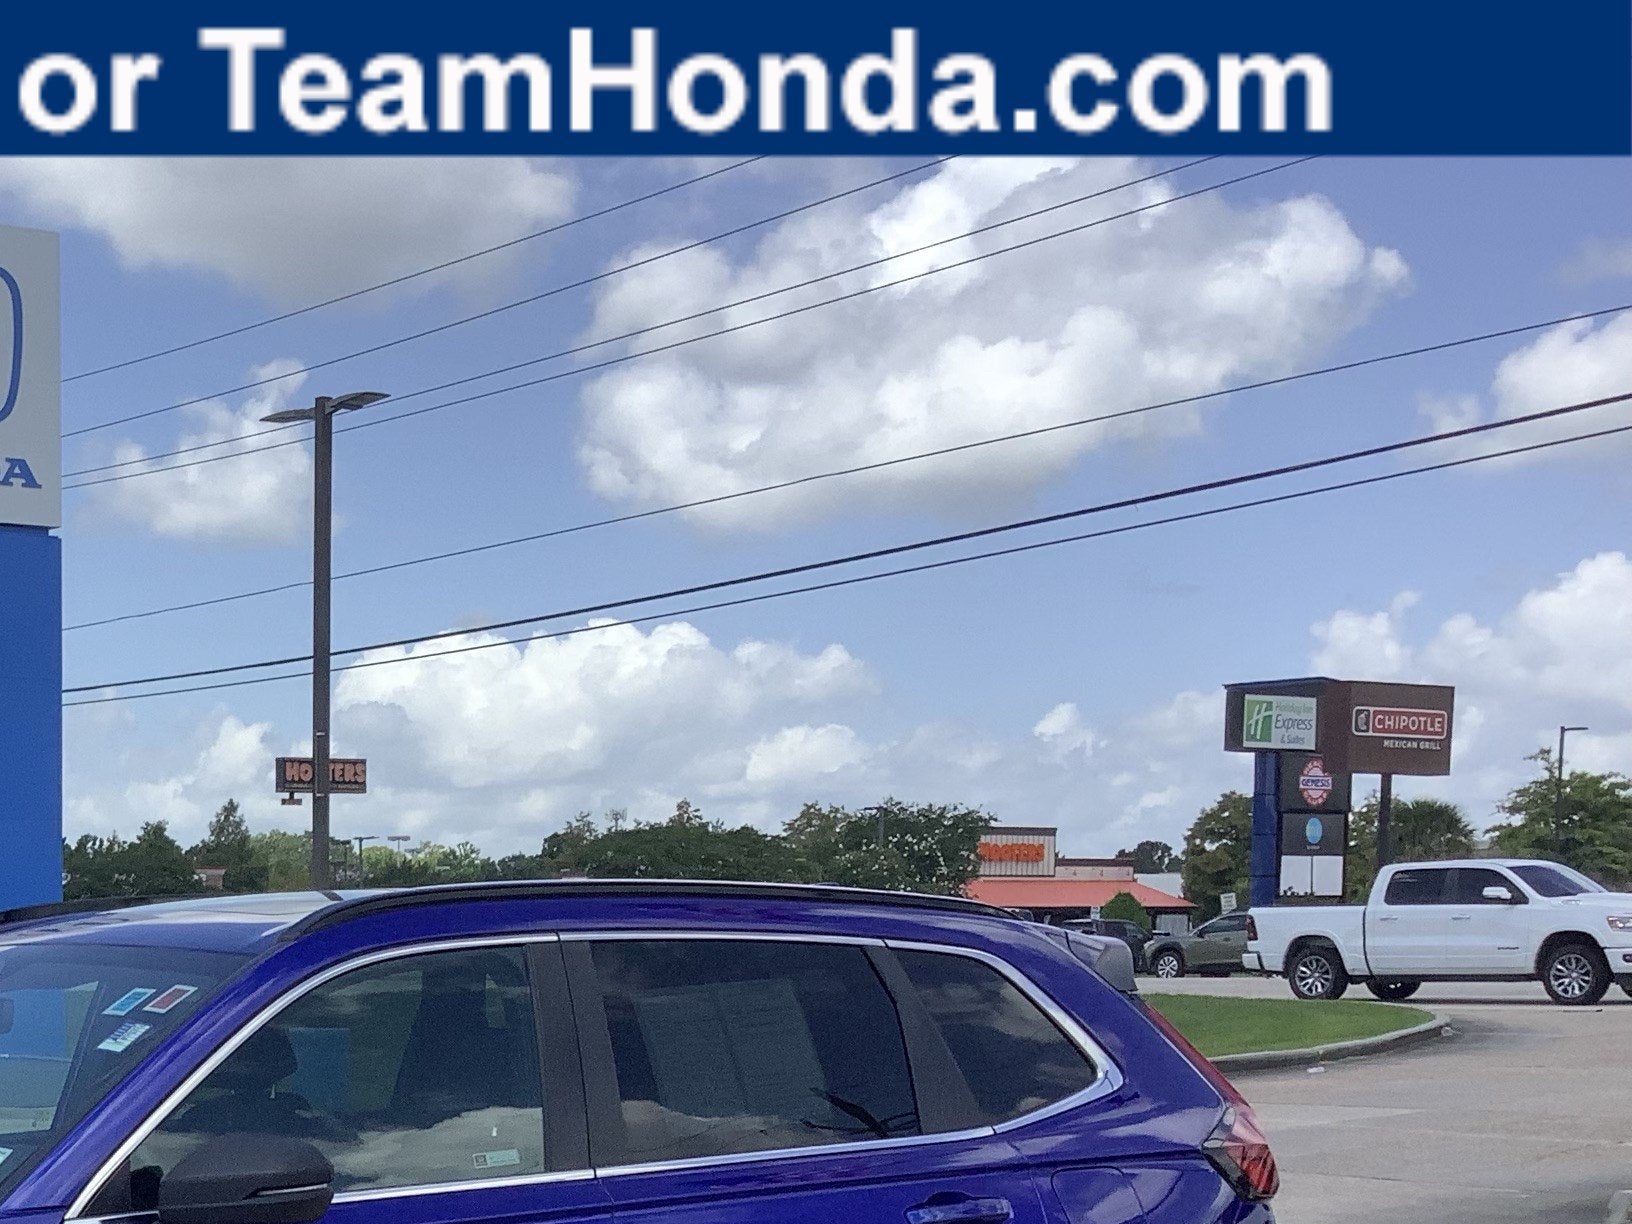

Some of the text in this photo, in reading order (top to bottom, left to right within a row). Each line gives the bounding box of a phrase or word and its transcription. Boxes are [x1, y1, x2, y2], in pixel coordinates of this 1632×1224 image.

[1274, 713, 1314, 732] Express
[1374, 714, 1444, 733] CHIPOTLE
[1287, 735, 1306, 745] Suites
[1383, 739, 1442, 751] MEXICAN GRILL
